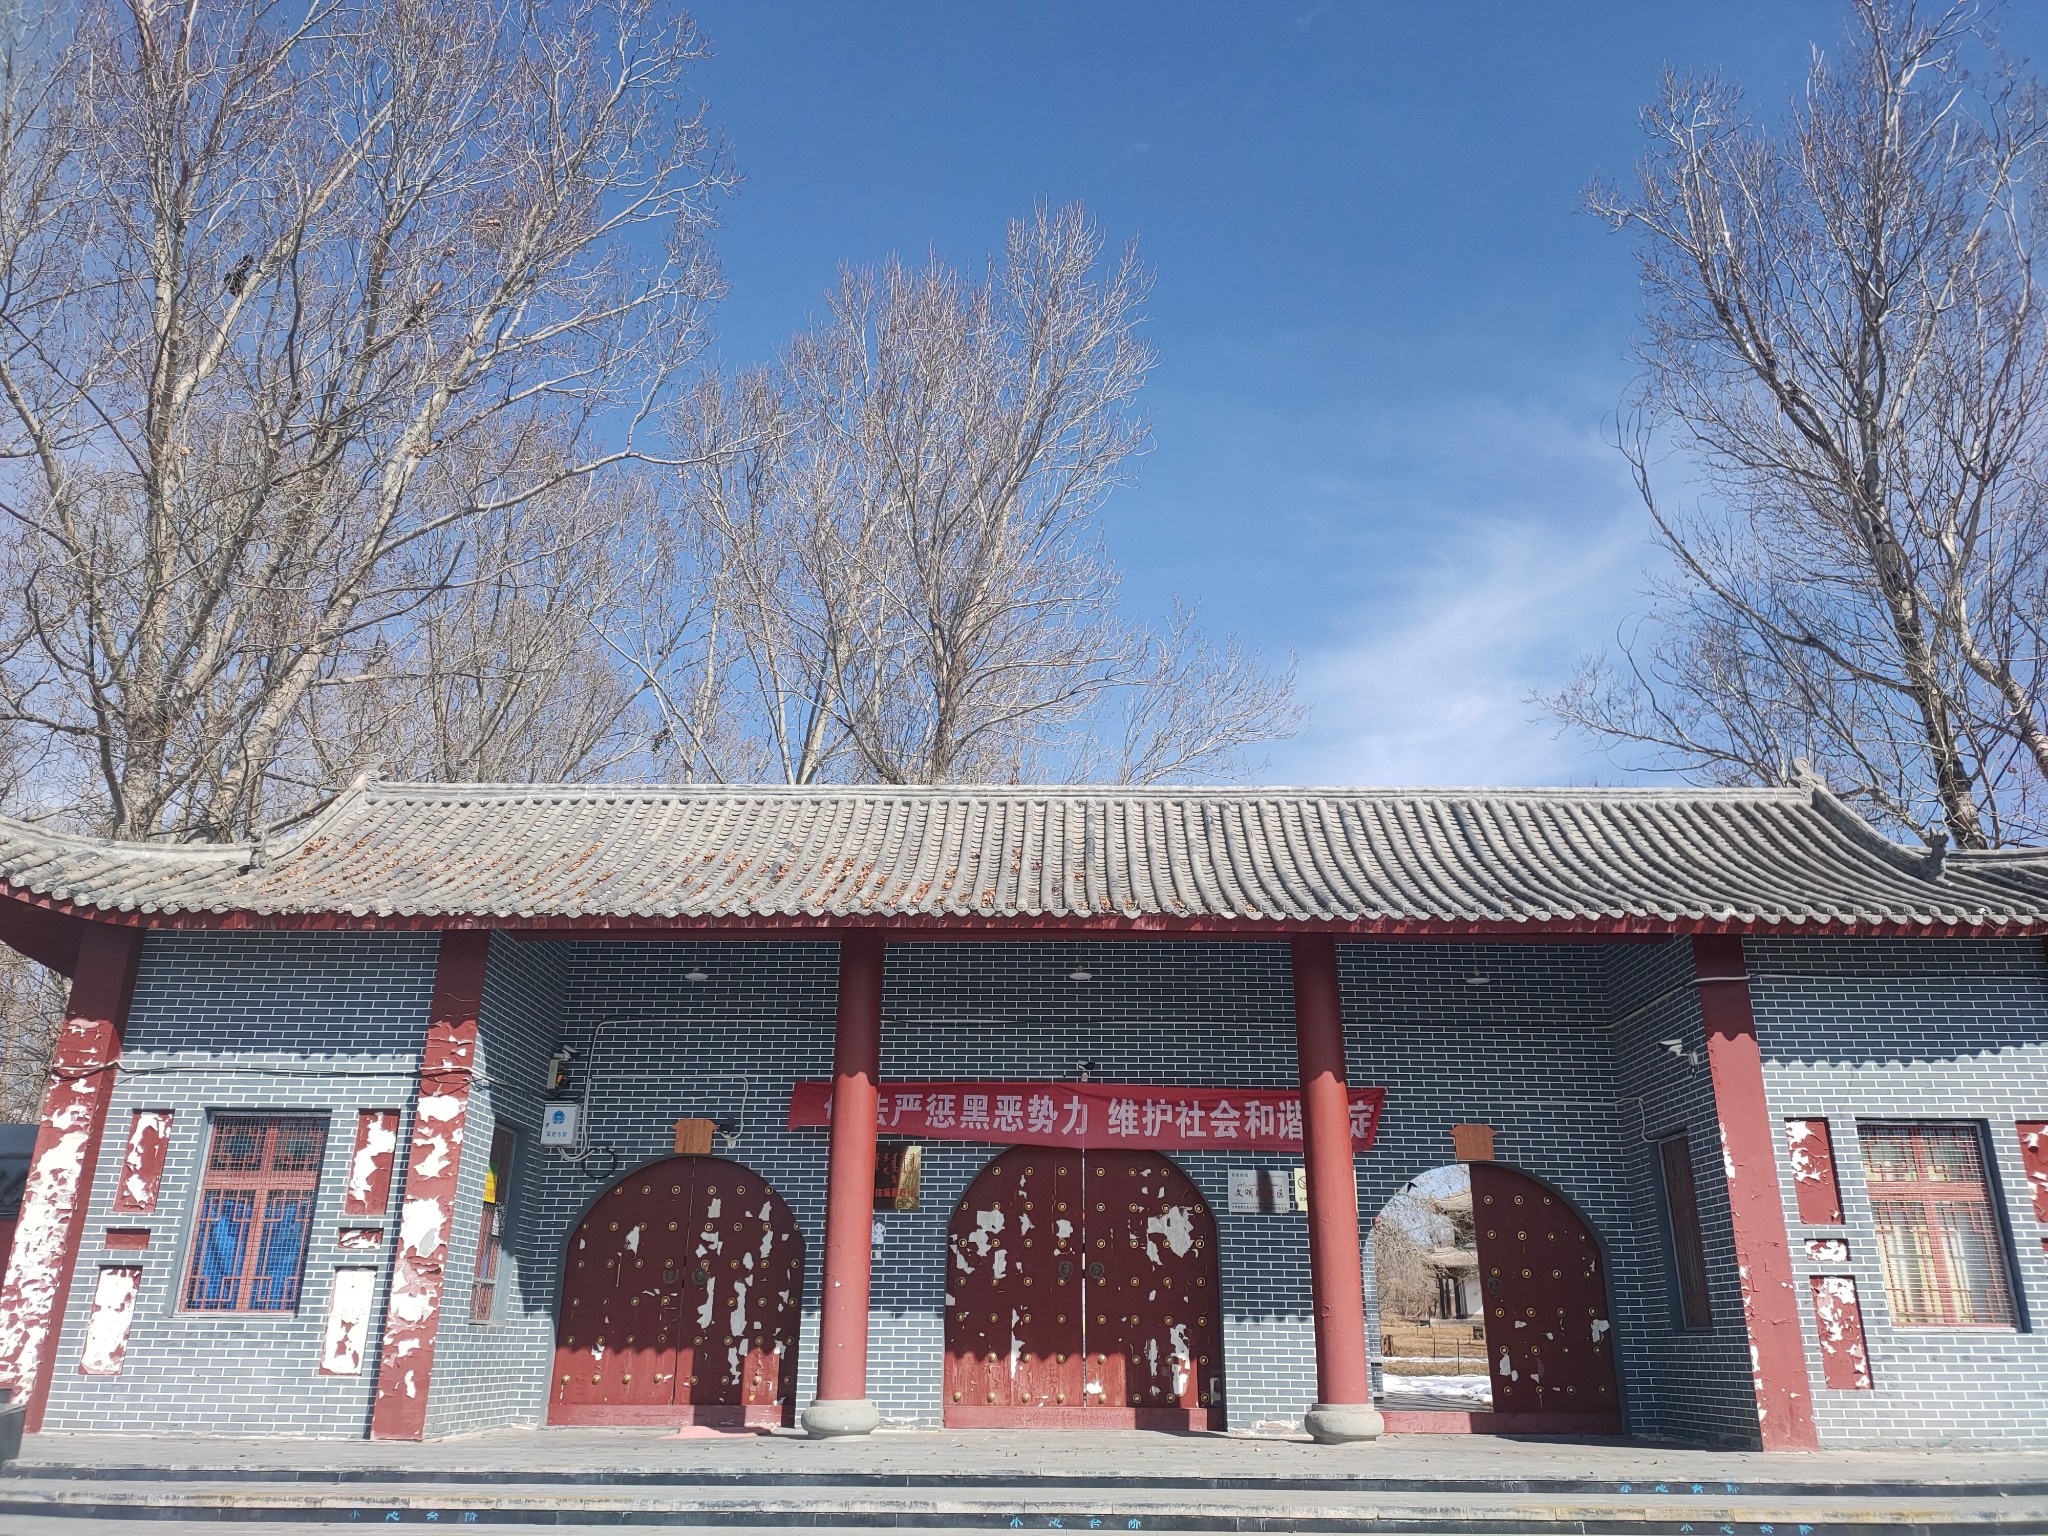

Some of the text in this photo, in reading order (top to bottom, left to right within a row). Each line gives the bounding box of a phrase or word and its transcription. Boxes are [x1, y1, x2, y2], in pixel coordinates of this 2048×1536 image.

[824, 1093, 1374, 1140] 严惩黑恶势力 维护社会和谐定
[348, 1509, 478, 1522] 小心台阶
[1009, 1516, 1142, 1529] 小心台阶
